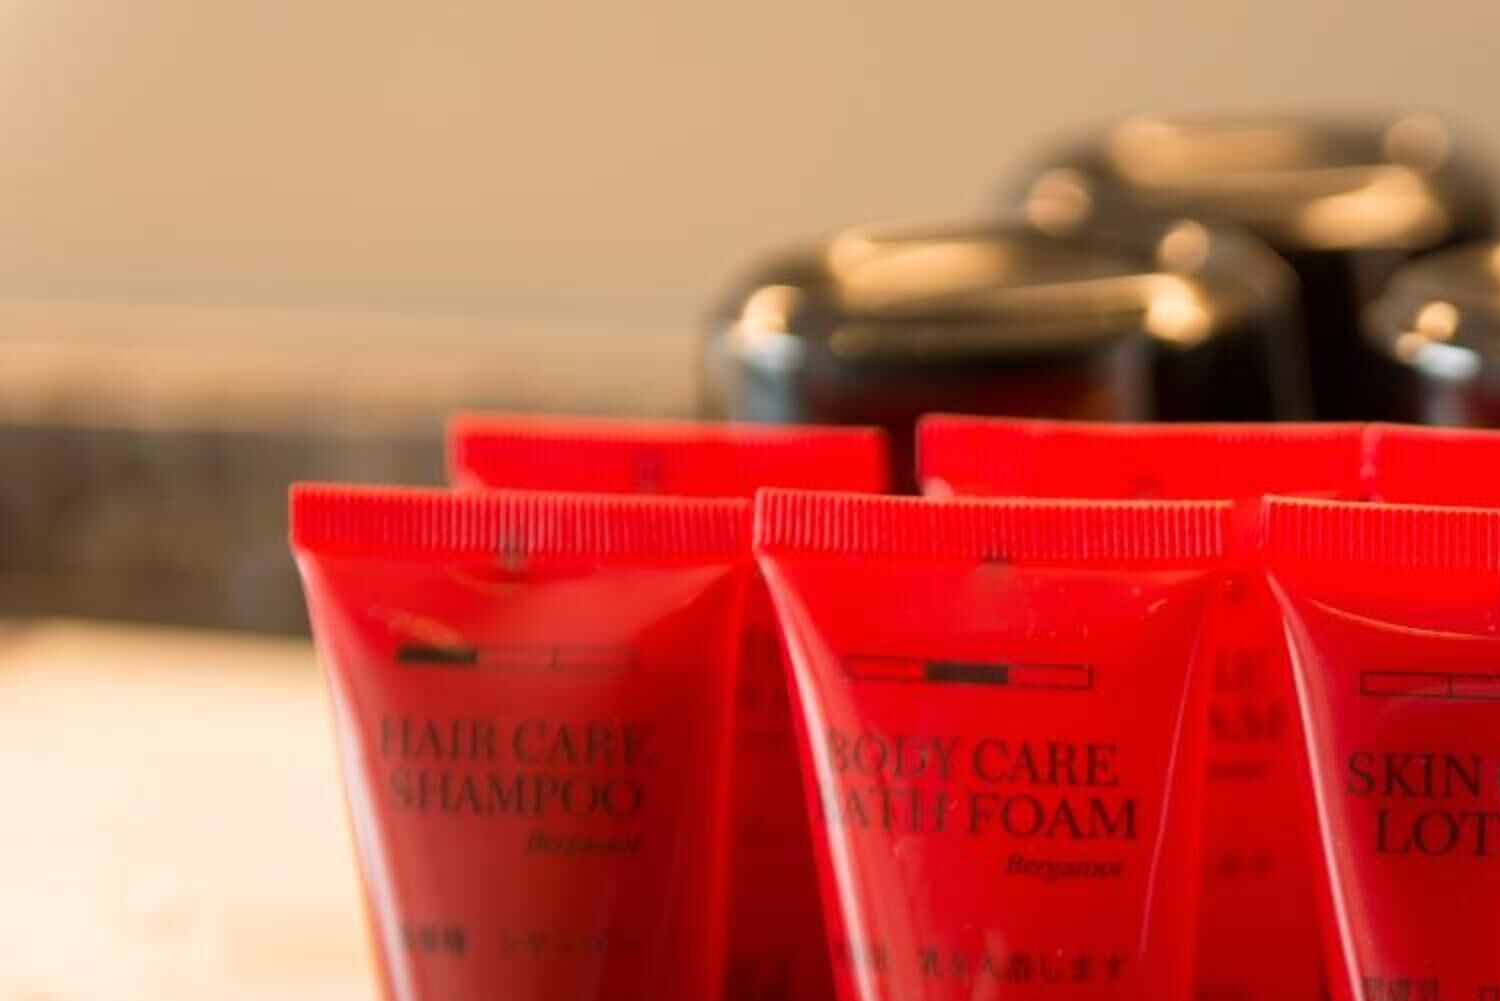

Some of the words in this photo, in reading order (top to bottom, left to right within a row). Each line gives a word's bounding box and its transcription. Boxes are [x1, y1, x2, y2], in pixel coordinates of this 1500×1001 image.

[381, 713, 497, 761] HAIR
[511, 719, 663, 768] CARE
[829, 729, 962, 781] BODY
[972, 738, 1121, 788] CARE
[388, 767, 644, 820] SHAMPOO
[1346, 750, 1484, 799] SKIN
[966, 792, 1138, 842] FOAM
[1004, 852, 1126, 888] Bergamot
